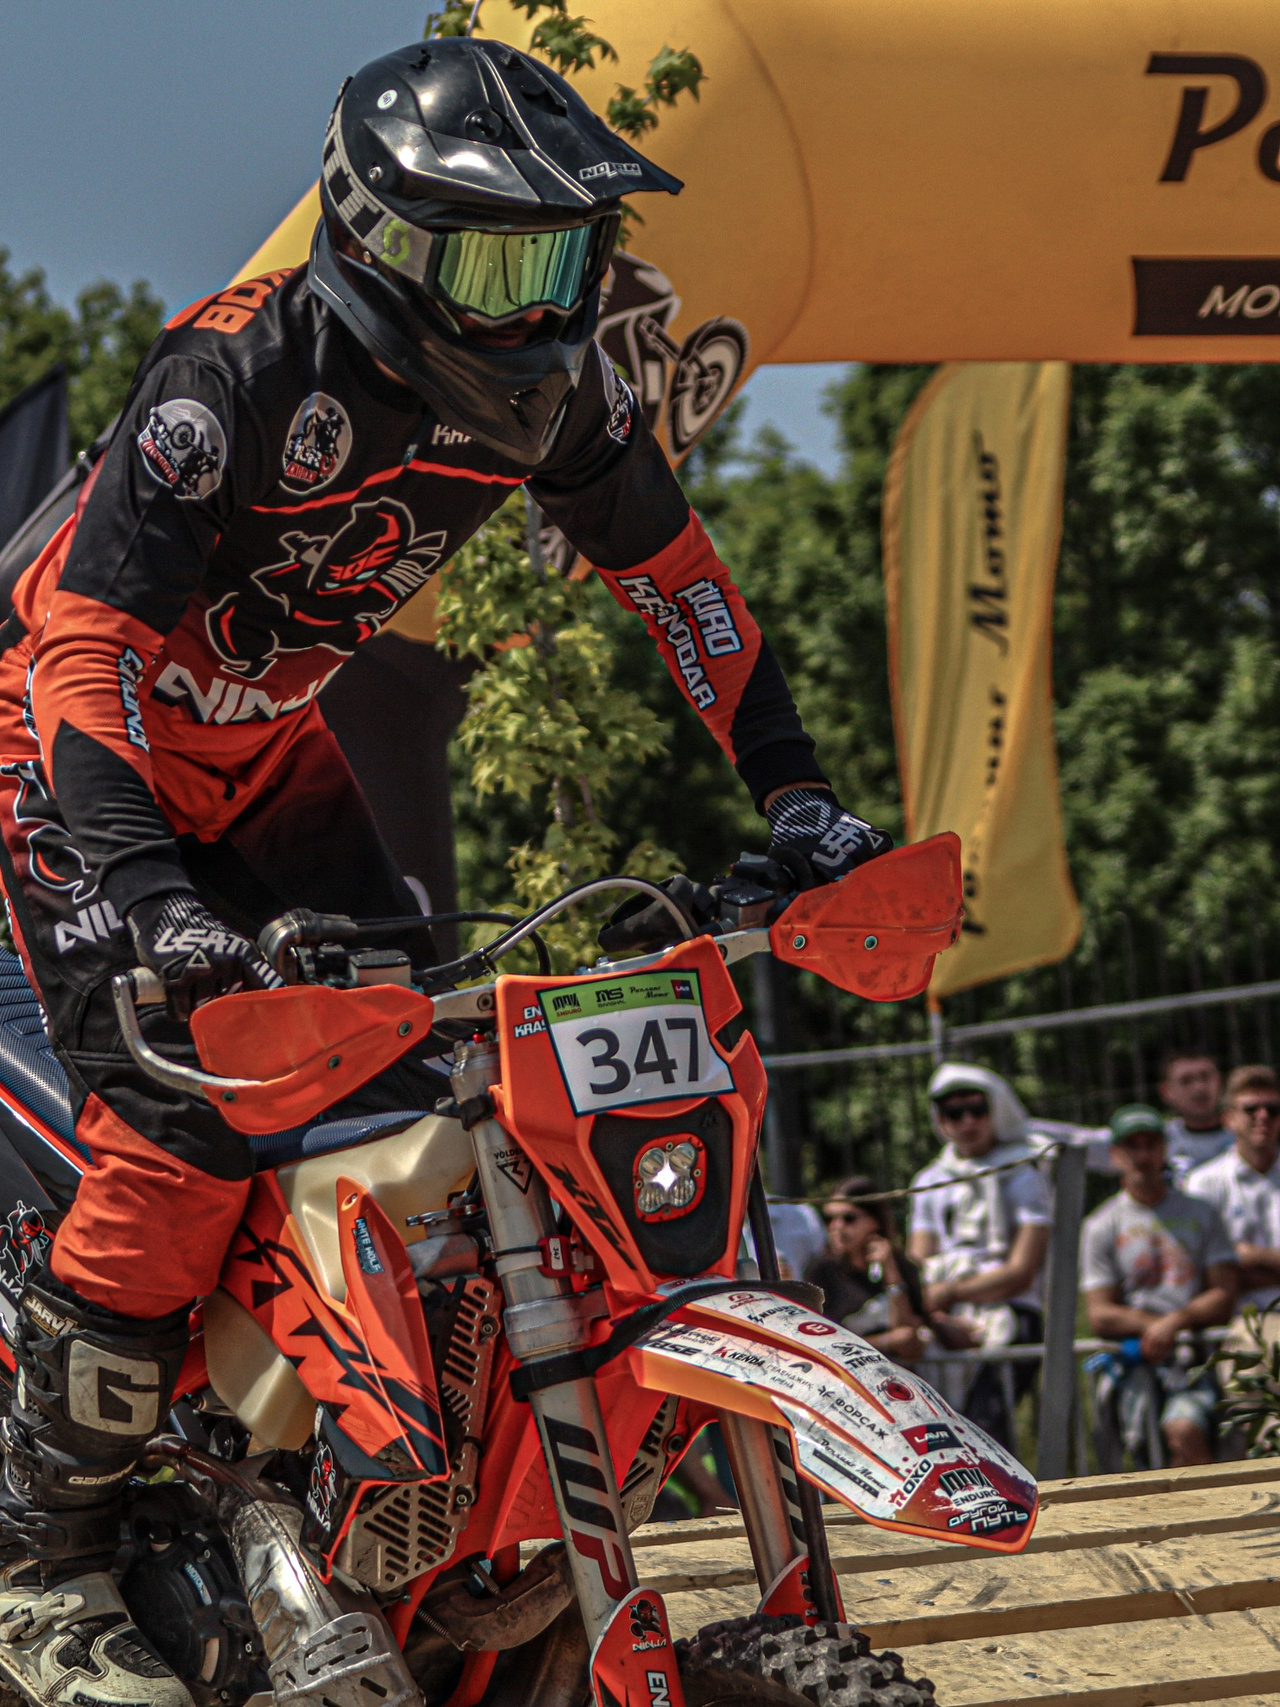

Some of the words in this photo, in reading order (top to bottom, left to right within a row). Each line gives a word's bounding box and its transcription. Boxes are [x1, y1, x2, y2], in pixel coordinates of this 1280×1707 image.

[579, 161, 642, 181] NOLAN
[576, 1017, 699, 1095] 347
[728, 1351, 766, 1367] KENDA
[834, 1397, 889, 1440] ФОРСАЖ
[914, 1430, 950, 1443] LAVR
[953, 1488, 1001, 1507] ENDURO
[948, 1501, 1008, 1528] ДРУГОЙ
[971, 1511, 1029, 1532] ПУТЬ
[632, 1638, 668, 1652] NINJA
